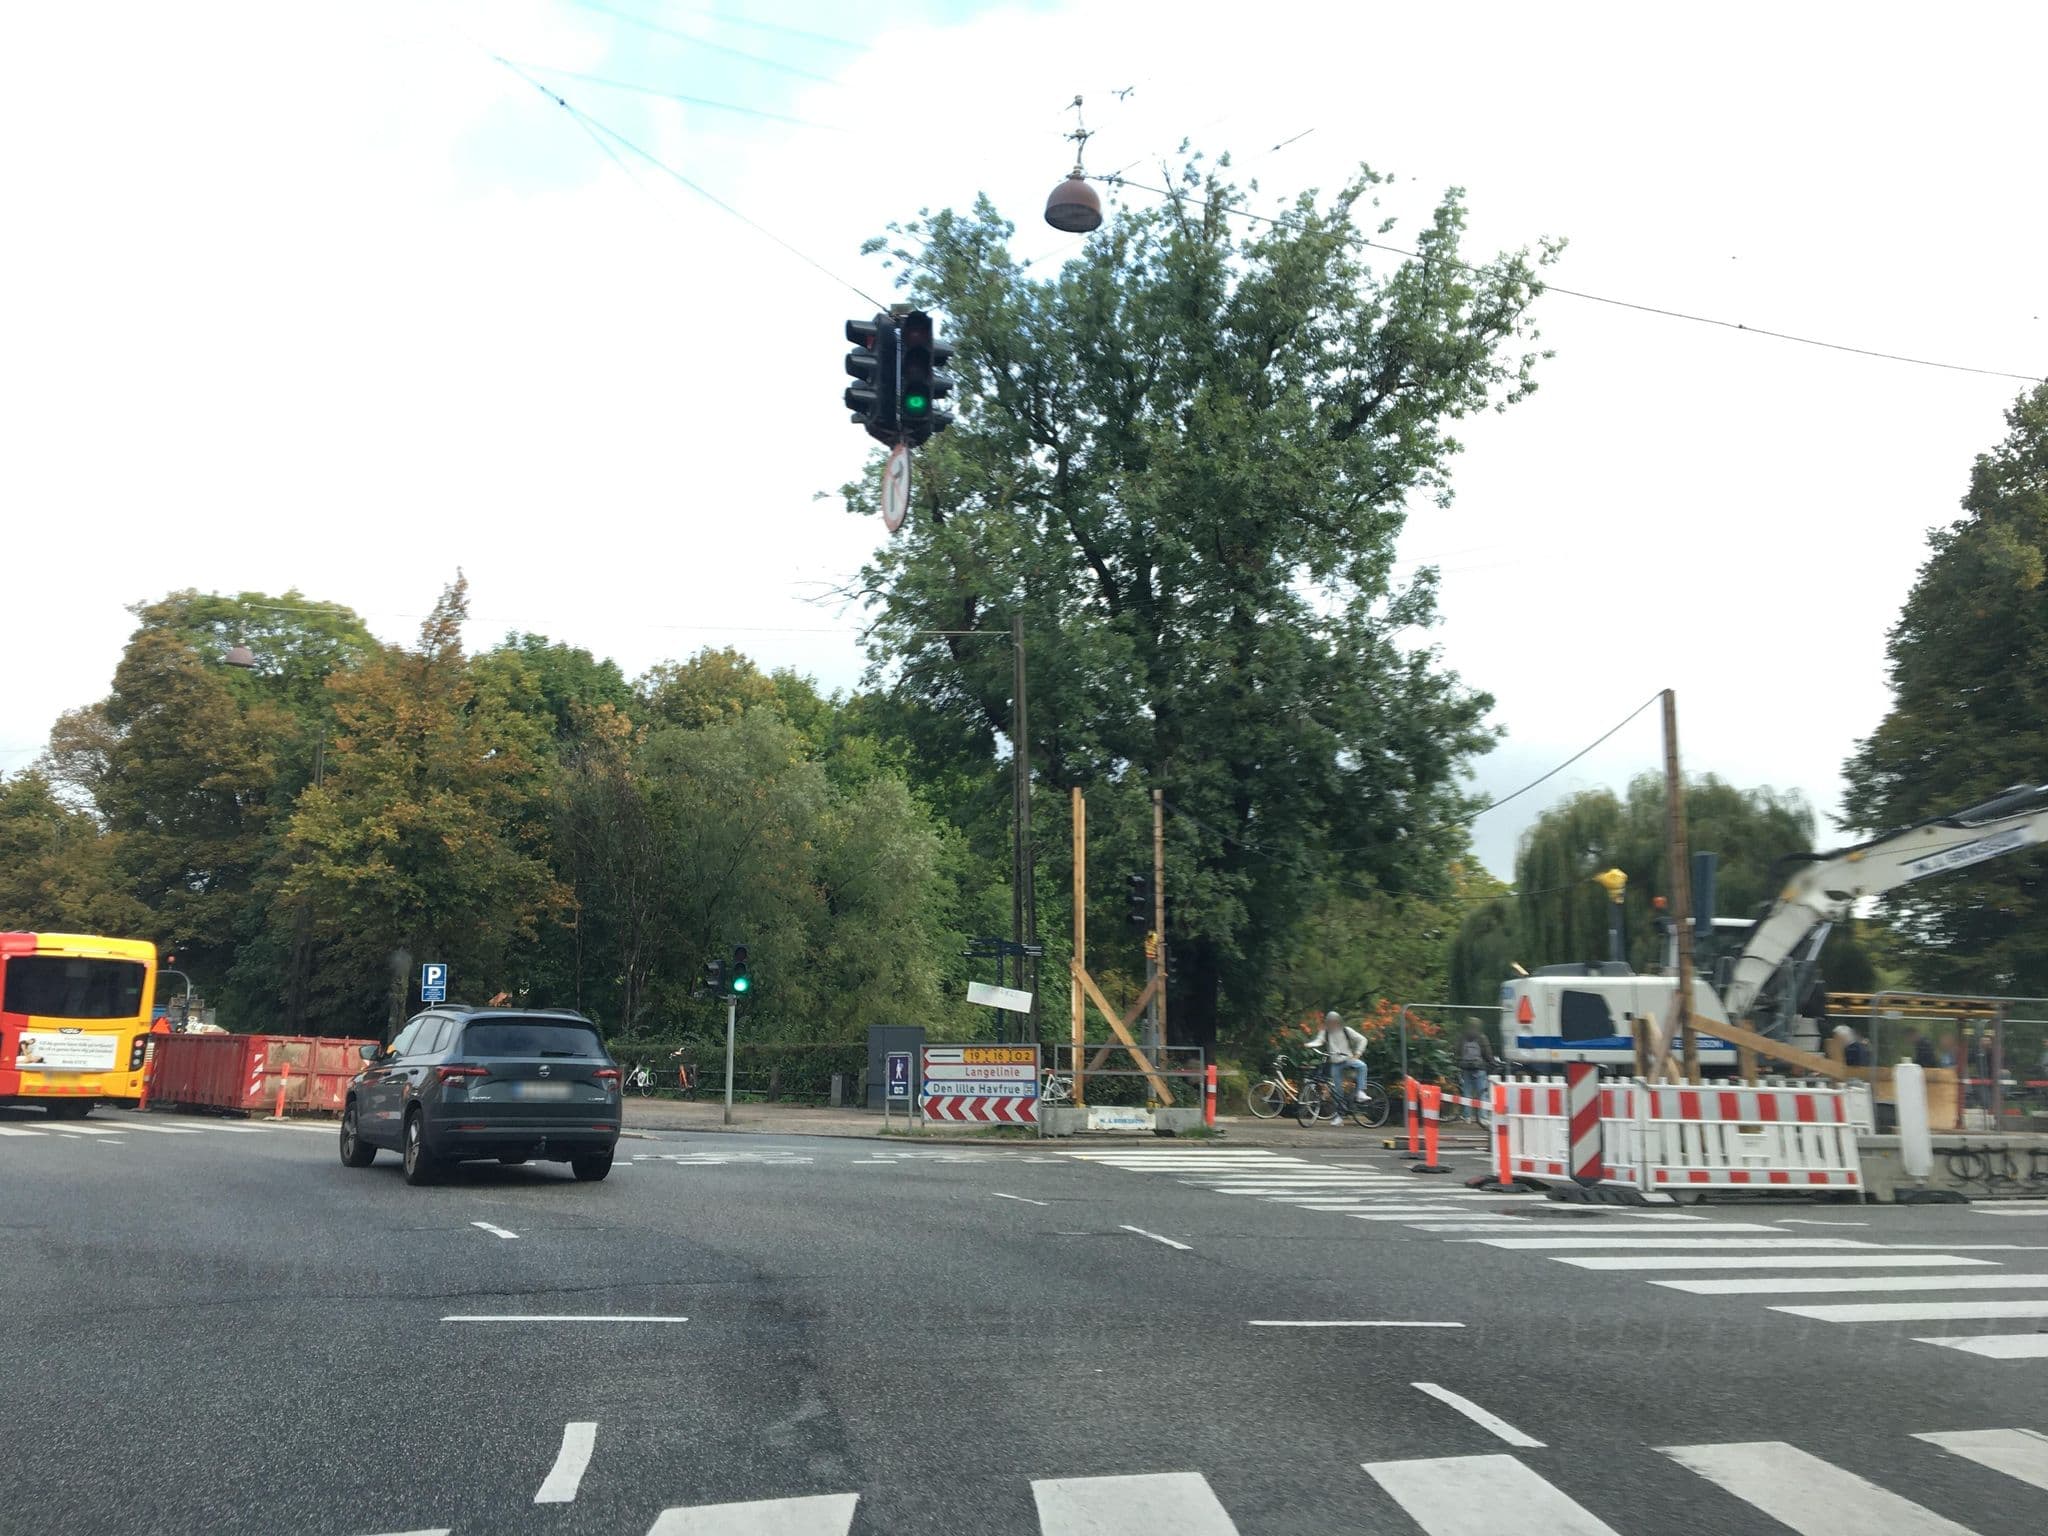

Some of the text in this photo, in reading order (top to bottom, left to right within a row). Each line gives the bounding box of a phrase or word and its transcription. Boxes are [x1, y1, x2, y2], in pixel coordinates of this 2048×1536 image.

[428, 966, 442, 985] P
[970, 1051, 980, 1059] 19
[993, 1051, 1004, 1059] 16
[965, 1067, 1020, 1078] Langelinie
[933, 1083, 1020, 1094] Den lille Havfrue
